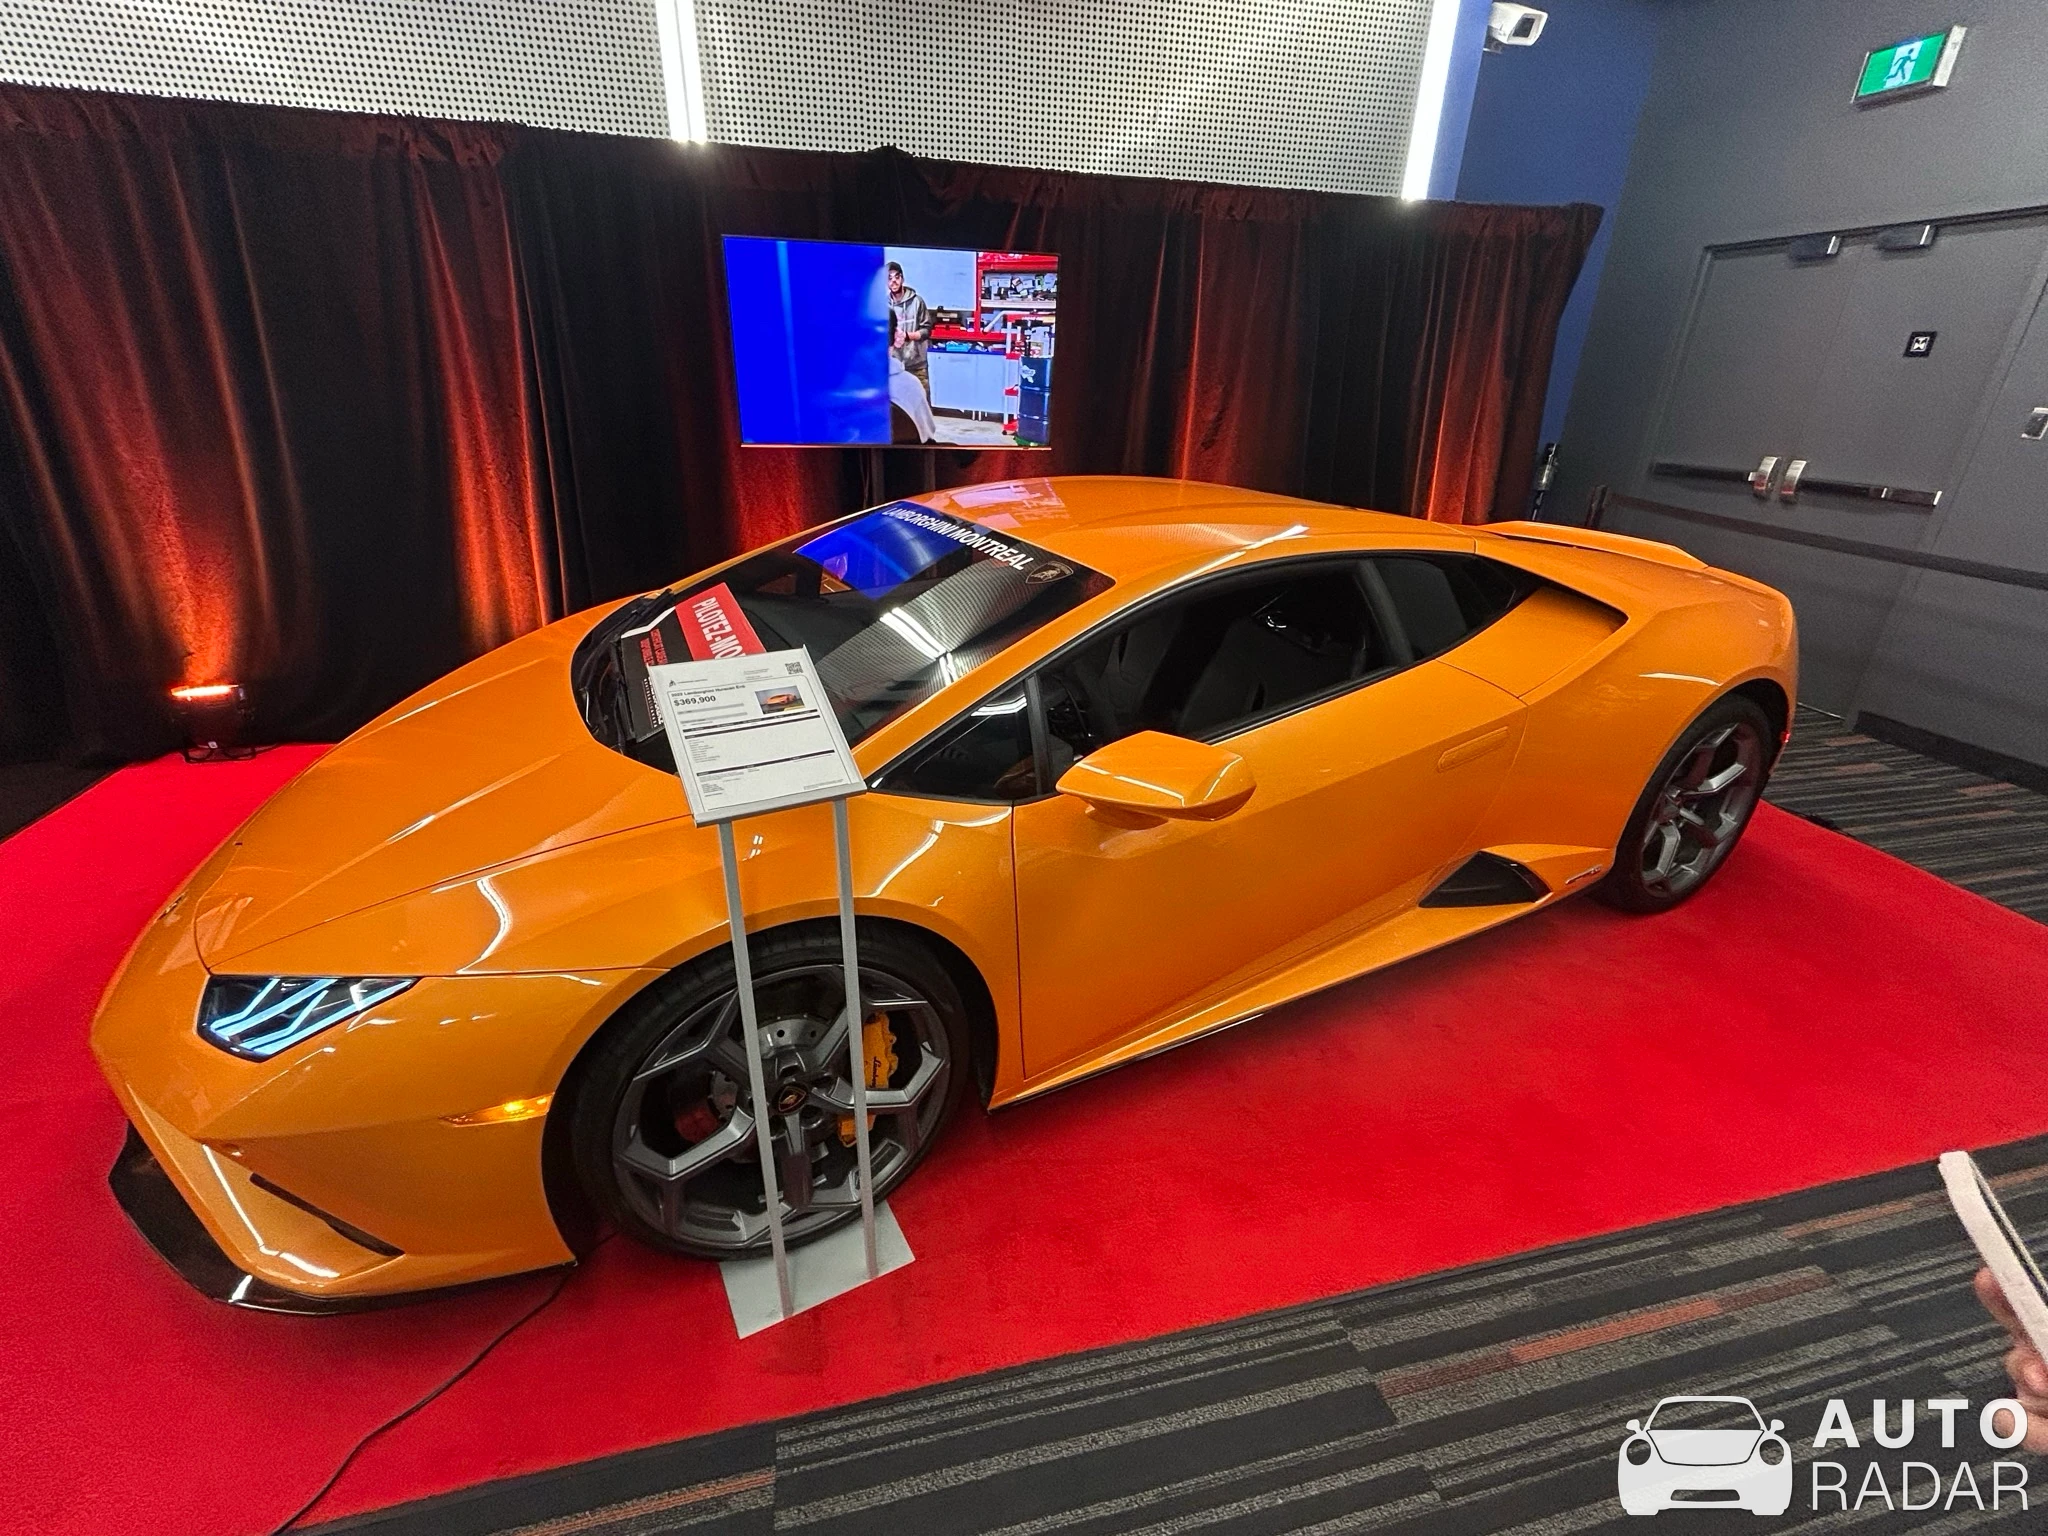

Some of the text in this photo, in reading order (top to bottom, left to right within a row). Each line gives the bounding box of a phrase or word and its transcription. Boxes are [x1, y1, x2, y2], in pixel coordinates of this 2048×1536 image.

[882, 508, 1034, 570] LAMBORGHINI MONTREAL
[692, 597, 746, 660] PILOTEZ-MO
[673, 695, 716, 706] $369,900
